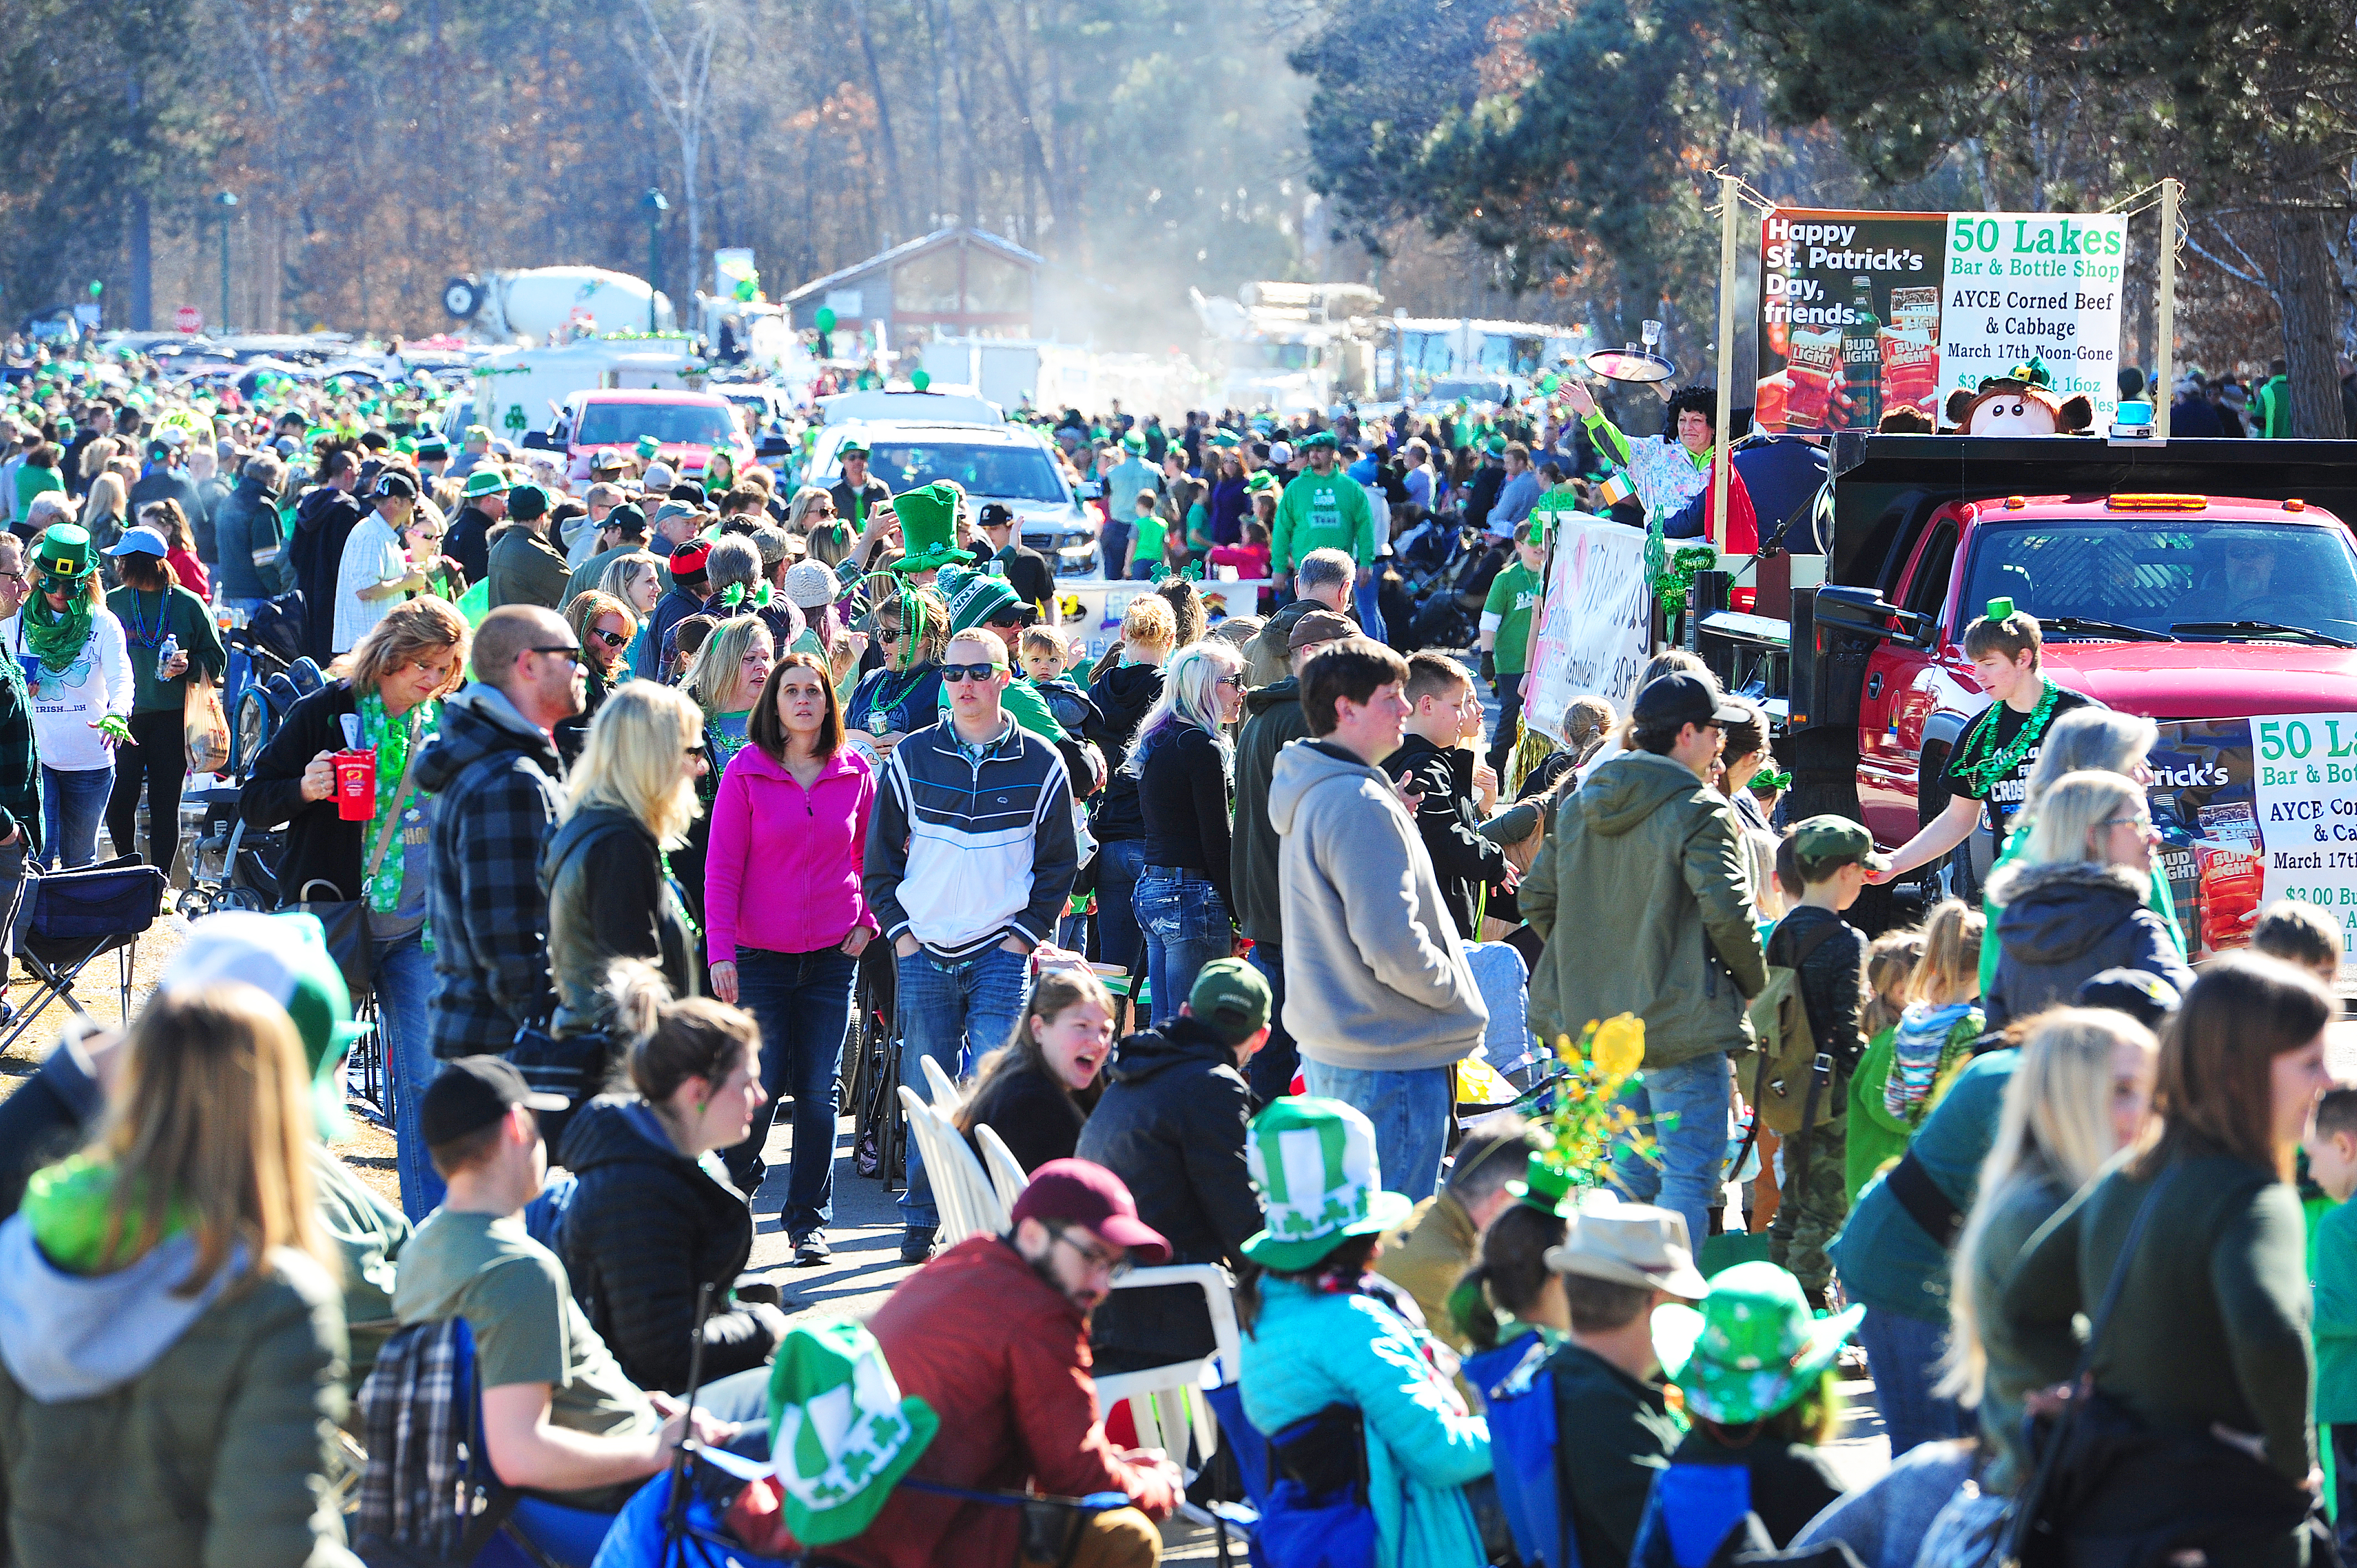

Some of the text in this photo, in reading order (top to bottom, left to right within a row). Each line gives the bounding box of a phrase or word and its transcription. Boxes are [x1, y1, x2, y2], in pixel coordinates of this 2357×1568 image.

[1768, 218, 1856, 246] Happy
[1953, 218, 2121, 255] 50 Lakes
[1766, 246, 1923, 271] St. Patrick's
[1951, 257, 2119, 283] Bar & Bottle Shop
[1766, 274, 1824, 301] Day,
[1952, 290, 2114, 311] AYCE Corned Beef
[1764, 301, 1862, 325] friends.
[1986, 316, 2076, 341] & Cabbage
[1845, 338, 1875, 350] BUD
[1894, 341, 1926, 354] BUD
[1948, 343, 2113, 360] March 17th Noon-Gone
[1793, 347, 1833, 365] LIGHT
[1843, 350, 1880, 363] LIGHT
[2065, 376, 2101, 392] 16oz
[2260, 720, 2357, 760] 50 L
[2144, 762, 2229, 787] rick's
[2262, 766, 2298, 786] Bar
[2307, 764, 2320, 783] &
[2271, 801, 2324, 822] AYCE
[2314, 824, 2357, 842] & Ca
[2213, 851, 2248, 866] BUD
[2273, 852, 2322, 869] March
